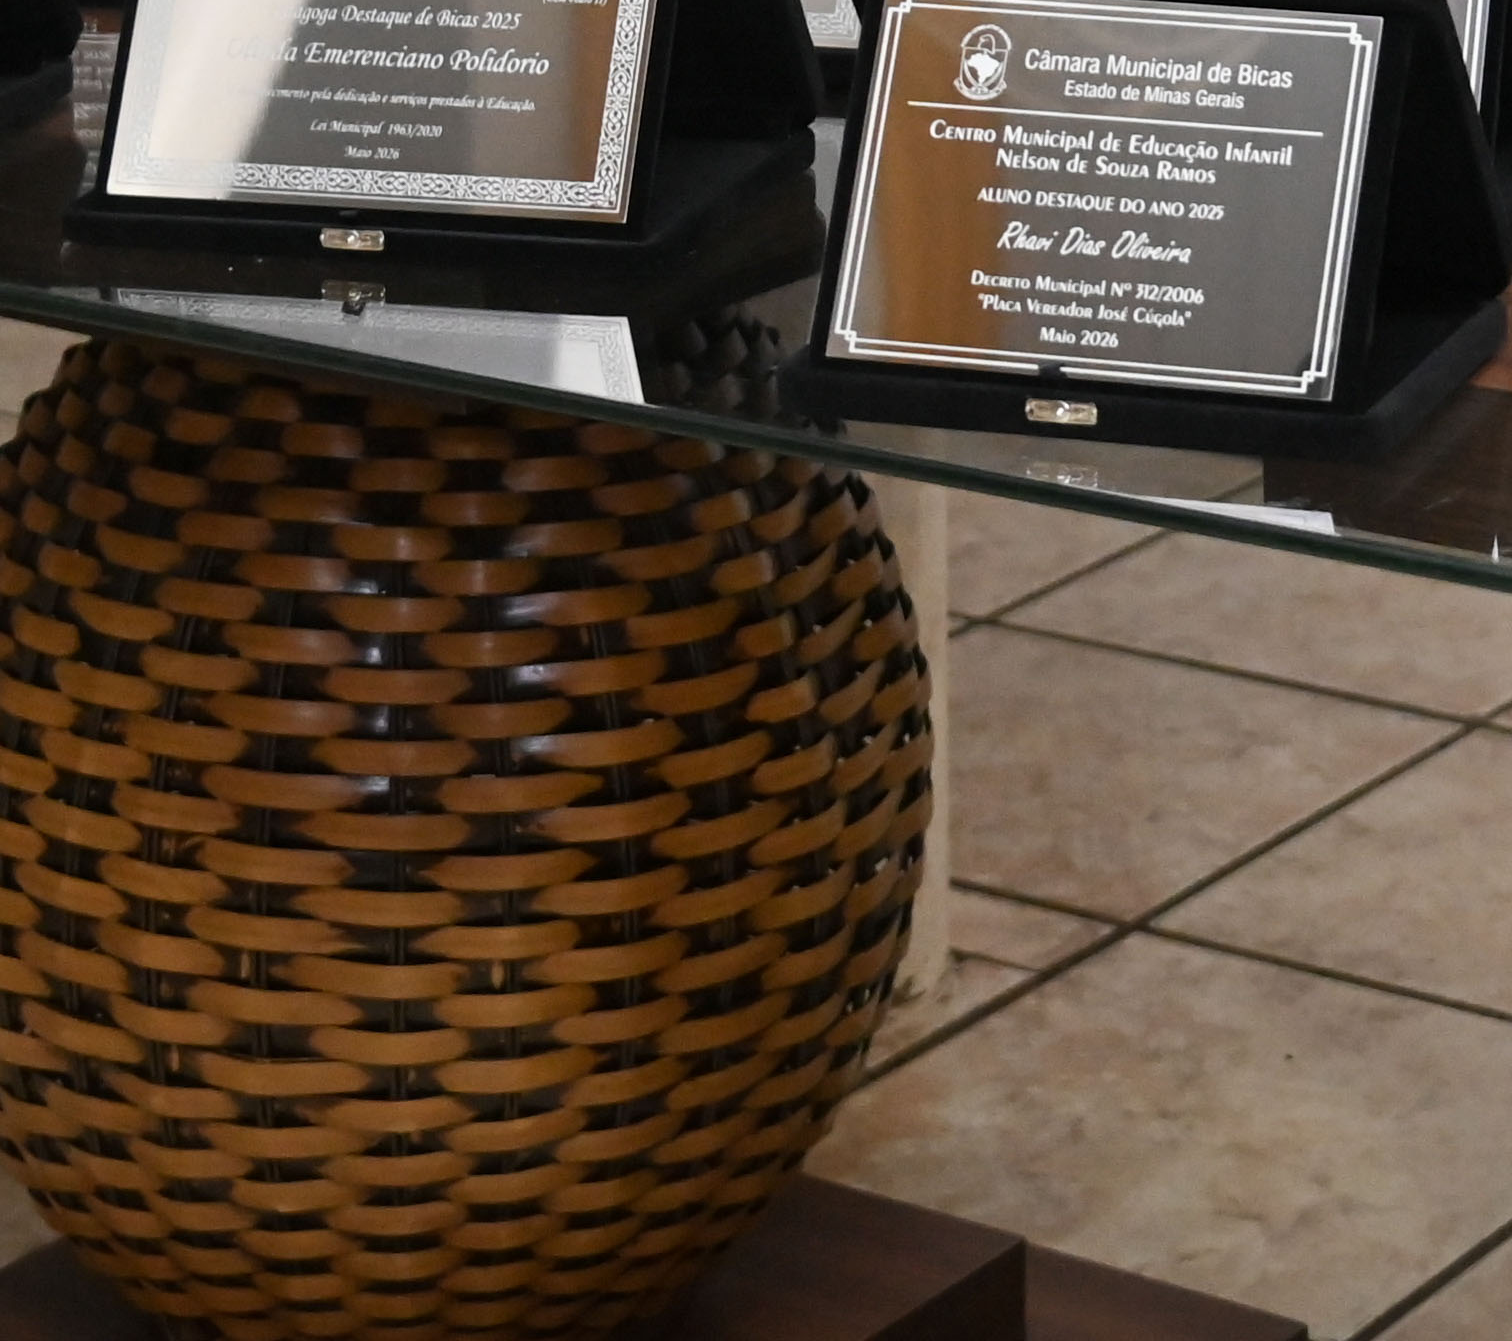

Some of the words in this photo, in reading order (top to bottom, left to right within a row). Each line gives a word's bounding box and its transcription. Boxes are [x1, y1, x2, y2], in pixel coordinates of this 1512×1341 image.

[341, 5, 413, 30] Destaque
[414, 6, 434, 26] de
[436, 9, 479, 28] Bicas
[481, 11, 522, 30] 2025
[304, 42, 444, 70] Emerenciano
[449, 47, 550, 75] Polidorio
[1024, 48, 1100, 74] Câmara
[1106, 54, 1202, 84] Municipal
[1207, 62, 1232, 84] de
[1237, 64, 1293, 89] Bicas
[1064, 79, 1117, 99] Estado
[1120, 84, 1140, 101] de
[1144, 85, 1191, 105] Minas
[1195, 89, 1245, 109] Gerais
[344, 145, 372, 158] Maio
[373, 147, 400, 160] 2026
[929, 119, 997, 143] Centro
[1003, 125, 1094, 153] Municipal
[1099, 131, 1122, 152] de
[1128, 134, 1219, 163] Educação
[1225, 142, 1293, 166] Infantil
[996, 148, 1060, 172] Nelson
[1066, 153, 1088, 174] de
[1095, 155, 1150, 178] Souza
[1156, 160, 1216, 184] Ramos
[977, 187, 1032, 205] ALUNO
[1035, 191, 1115, 212] DESTAQUE
[1119, 197, 1146, 214] DO
[1148, 201, 1185, 217] ANO
[1188, 203, 1225, 220] 2025
[996, 221, 1059, 251] Rhavi
[1059, 226, 1106, 256] Dias
[1111, 230, 1192, 264] Oliveira
